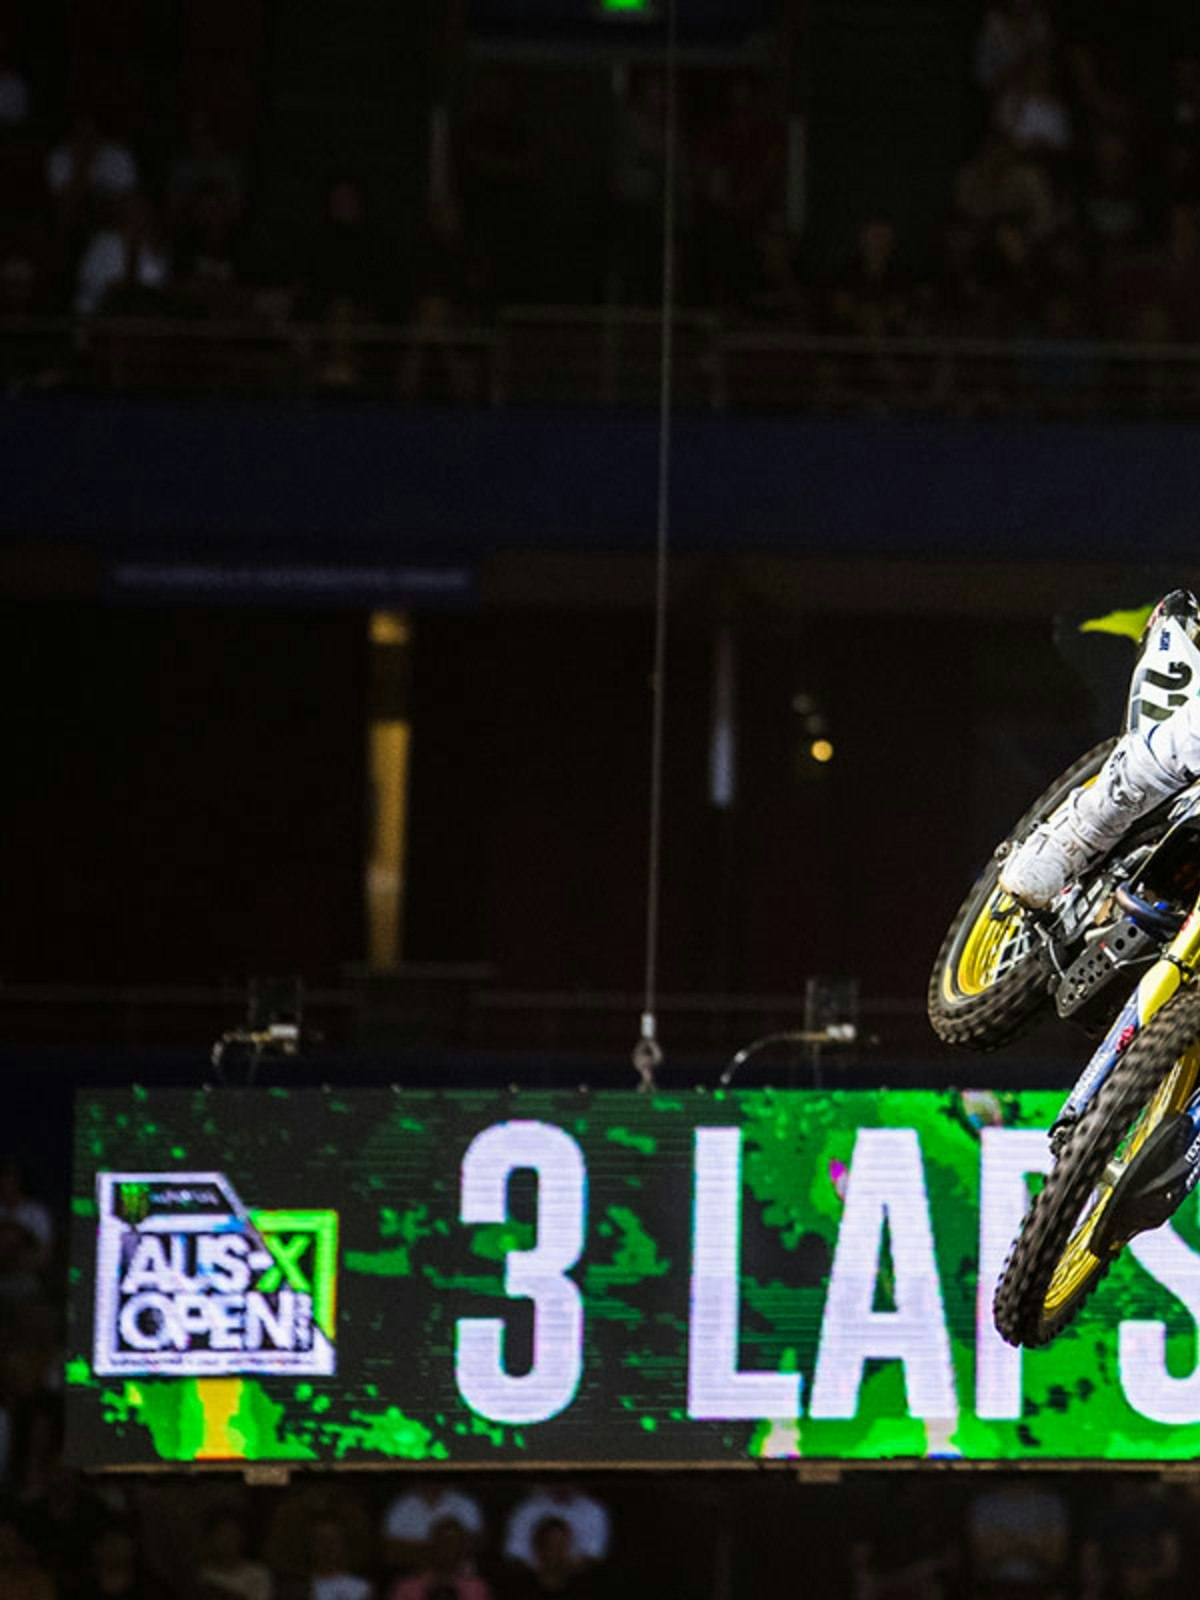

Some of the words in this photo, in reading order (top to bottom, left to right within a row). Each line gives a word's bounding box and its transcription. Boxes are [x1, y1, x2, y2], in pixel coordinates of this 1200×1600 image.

[121, 1232, 312, 1294] AUS-X
[456, 1119, 588, 1425] 3
[118, 1289, 296, 1352] OPEN
